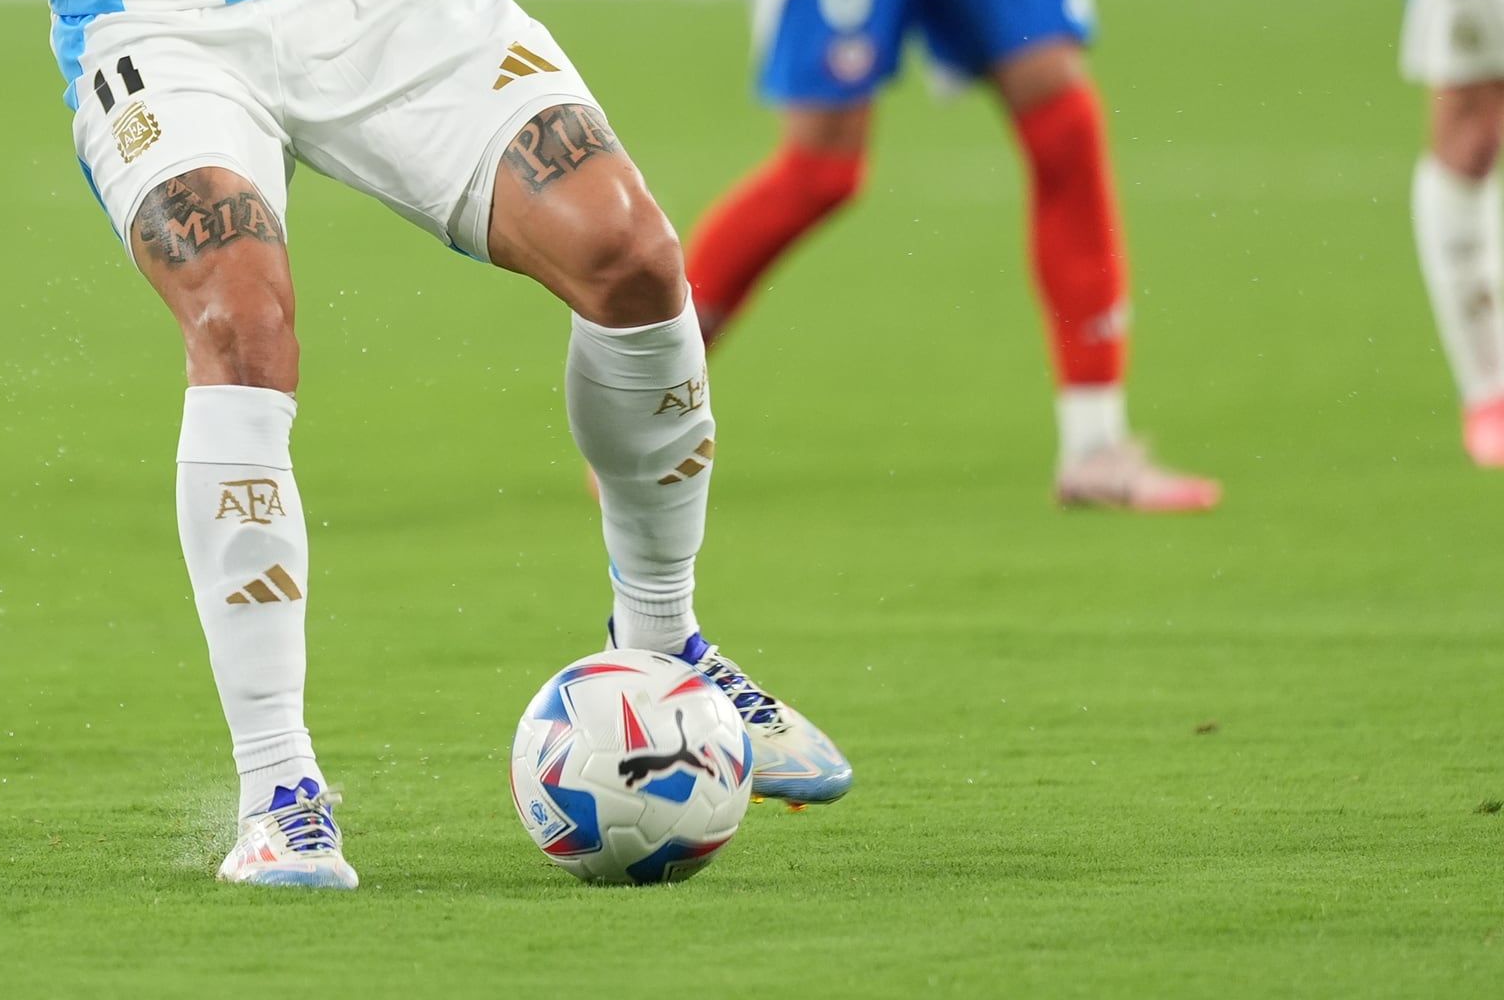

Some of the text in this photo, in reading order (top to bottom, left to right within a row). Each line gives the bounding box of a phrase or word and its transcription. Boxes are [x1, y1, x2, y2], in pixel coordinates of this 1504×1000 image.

[94, 56, 144, 115] 11
[164, 196, 280, 261] MIA
[215, 478, 286, 525] AFA
